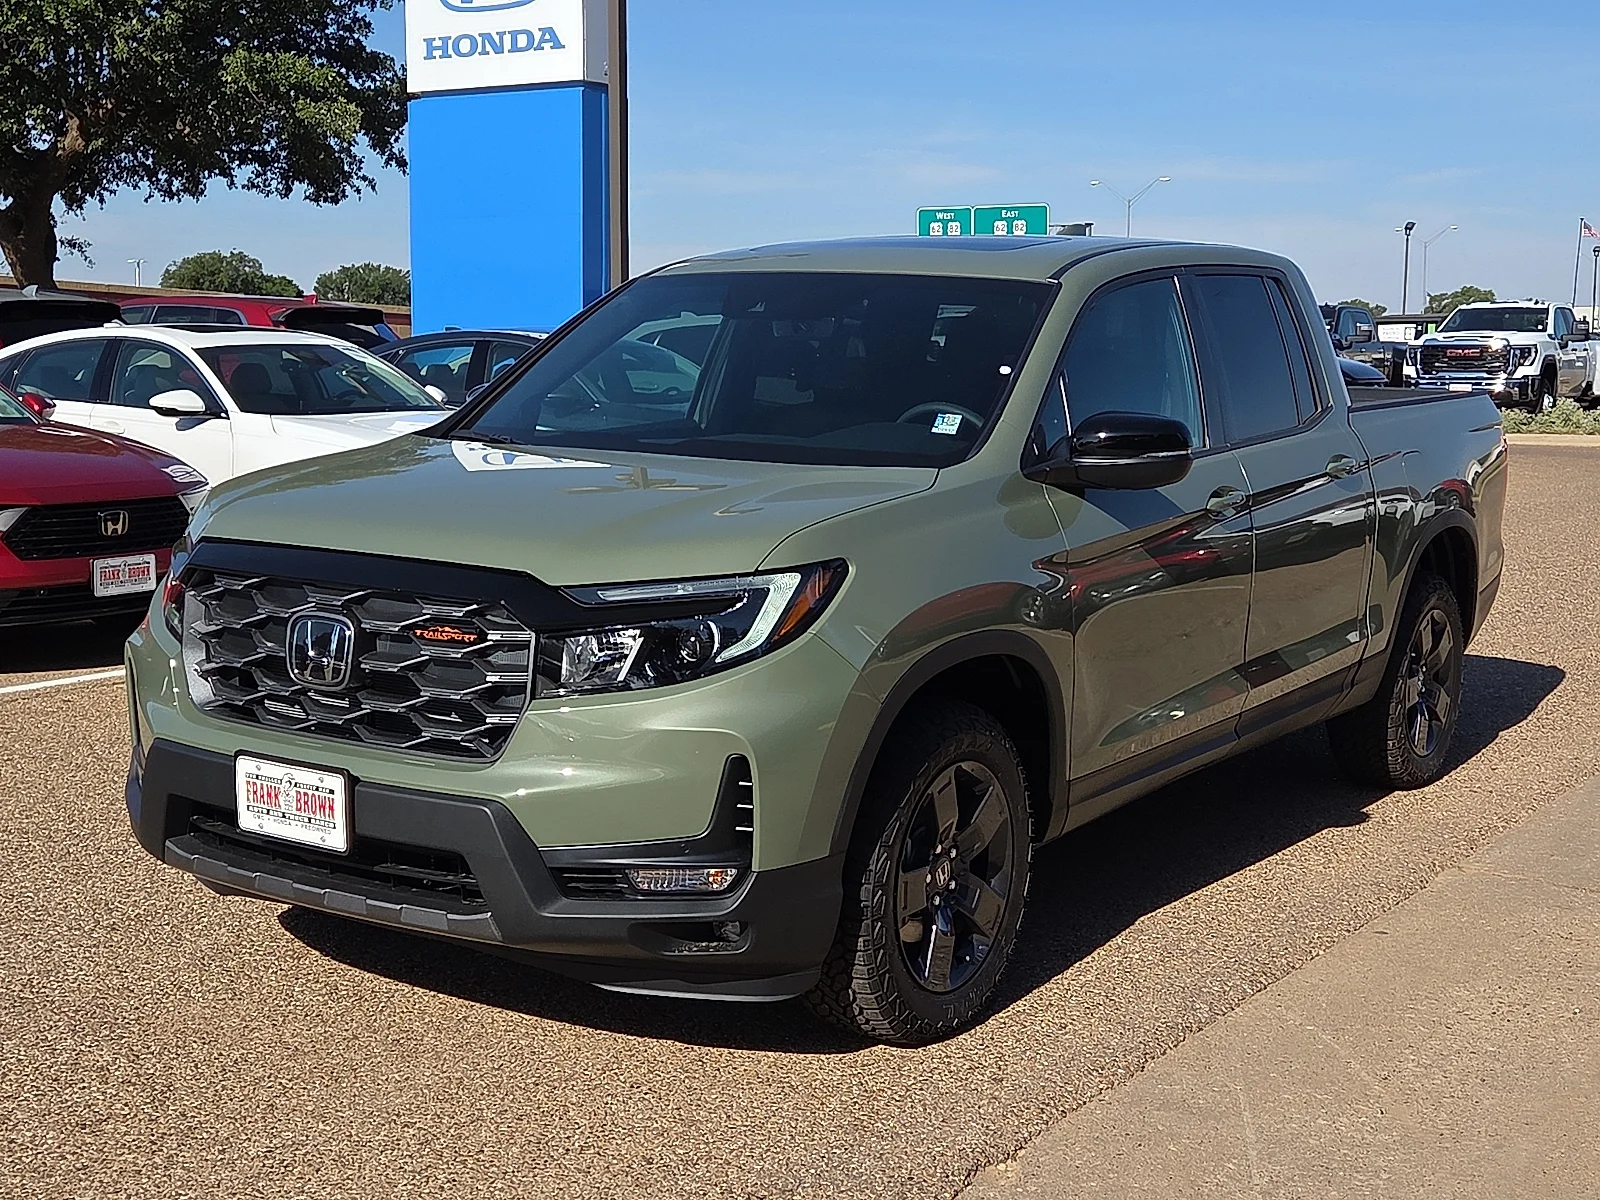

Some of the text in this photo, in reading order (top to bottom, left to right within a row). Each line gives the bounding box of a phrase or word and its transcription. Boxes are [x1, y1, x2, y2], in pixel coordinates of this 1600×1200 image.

[423, 26, 565, 60] HONDA
[931, 225, 941, 233] 62
[948, 225, 959, 233] 82
[995, 223, 1006, 232] 62
[1014, 223, 1025, 232] 82
[1446, 348, 1480, 357] GMC
[414, 629, 478, 643] TRAILSPORT
[245, 780, 281, 809] FRANK
[295, 790, 335, 820] BROWN
